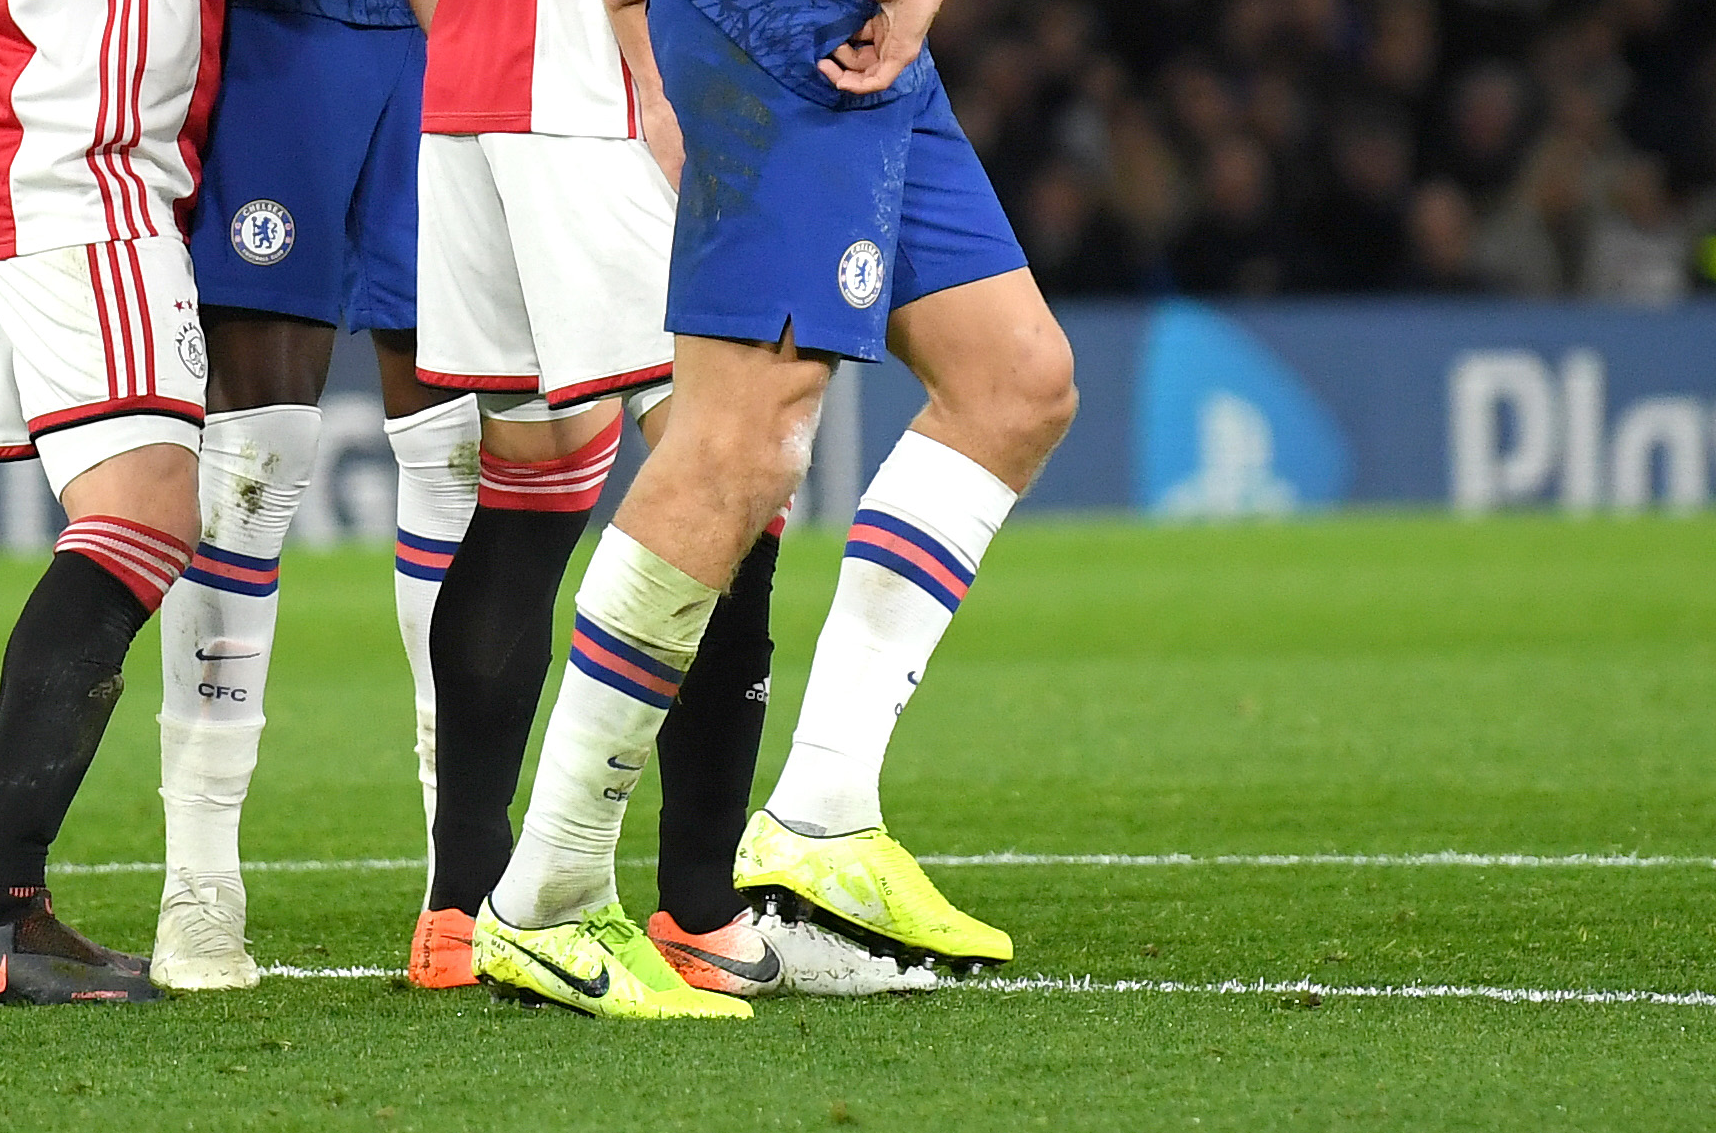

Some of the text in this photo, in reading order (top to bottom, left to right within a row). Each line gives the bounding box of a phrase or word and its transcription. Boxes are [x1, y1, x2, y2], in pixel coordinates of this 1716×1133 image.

[242, 202, 285, 218] CHELSEA
[174, 321, 194, 346] AJAX
[198, 682, 248, 703] CFC
